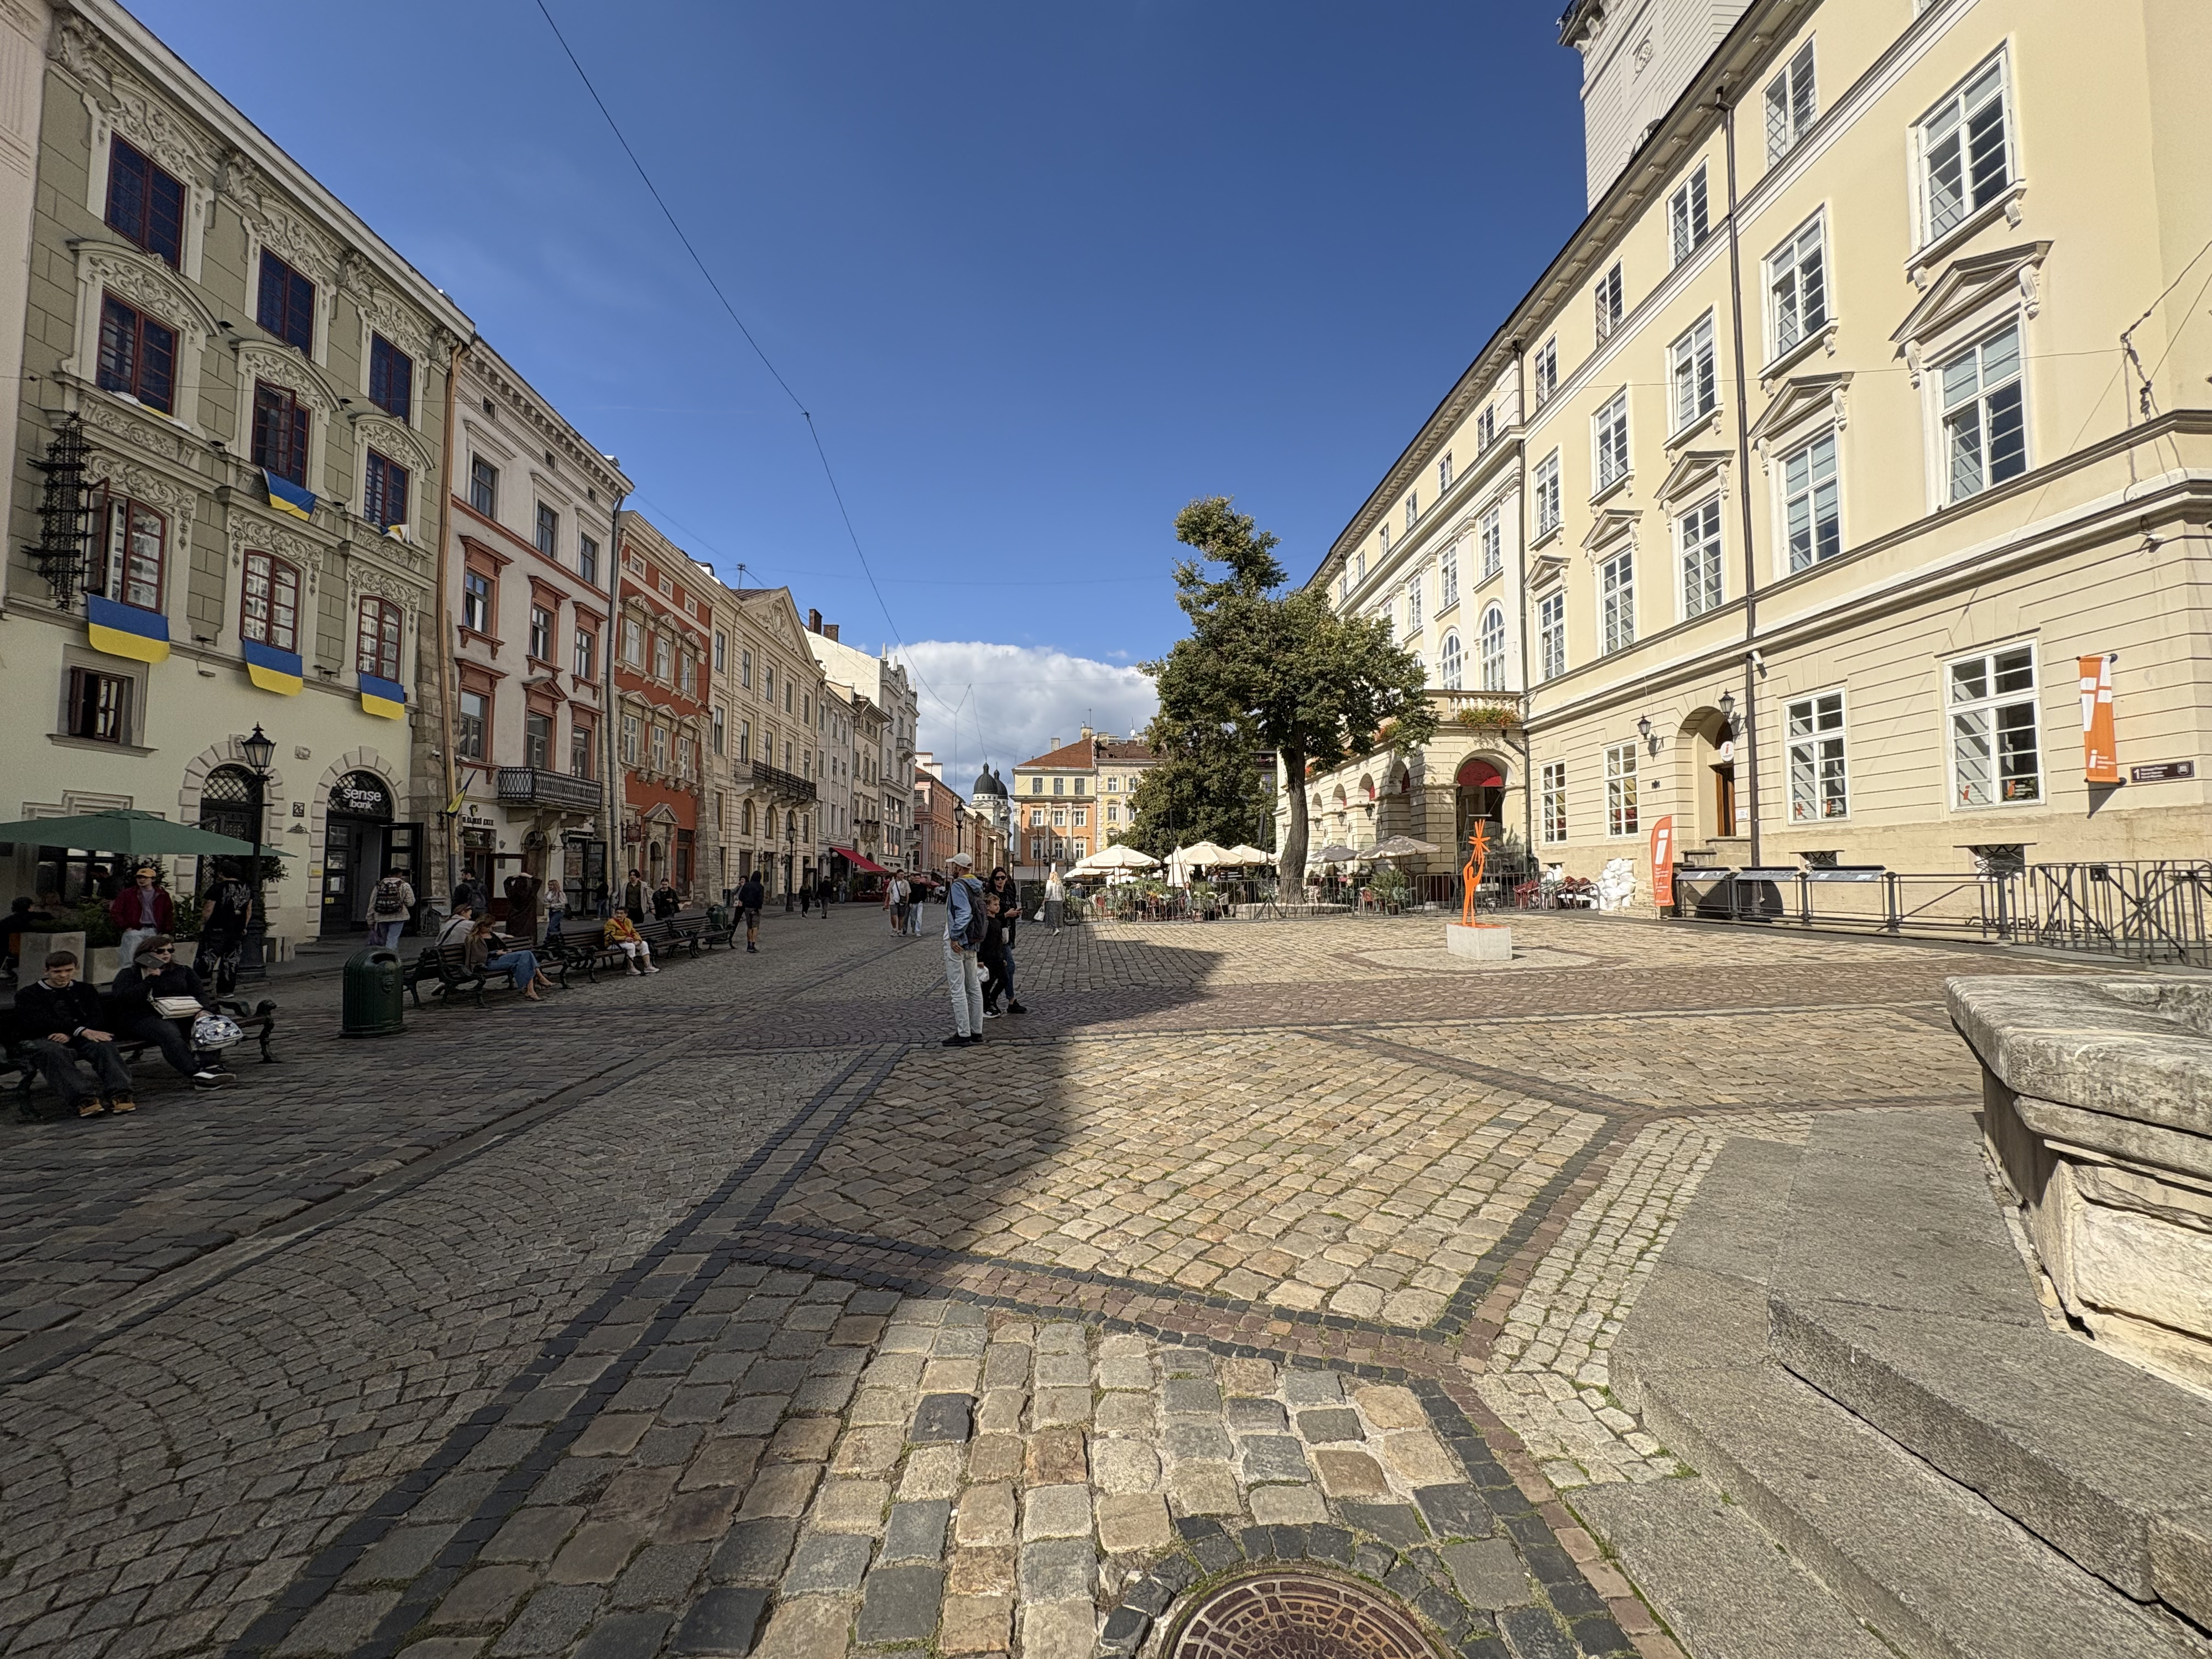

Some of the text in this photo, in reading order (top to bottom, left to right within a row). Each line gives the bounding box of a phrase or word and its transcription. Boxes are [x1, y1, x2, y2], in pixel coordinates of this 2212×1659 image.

[2133, 768, 2140, 779] 1
[343, 788, 382, 802] sense
[349, 799, 373, 810] bank
